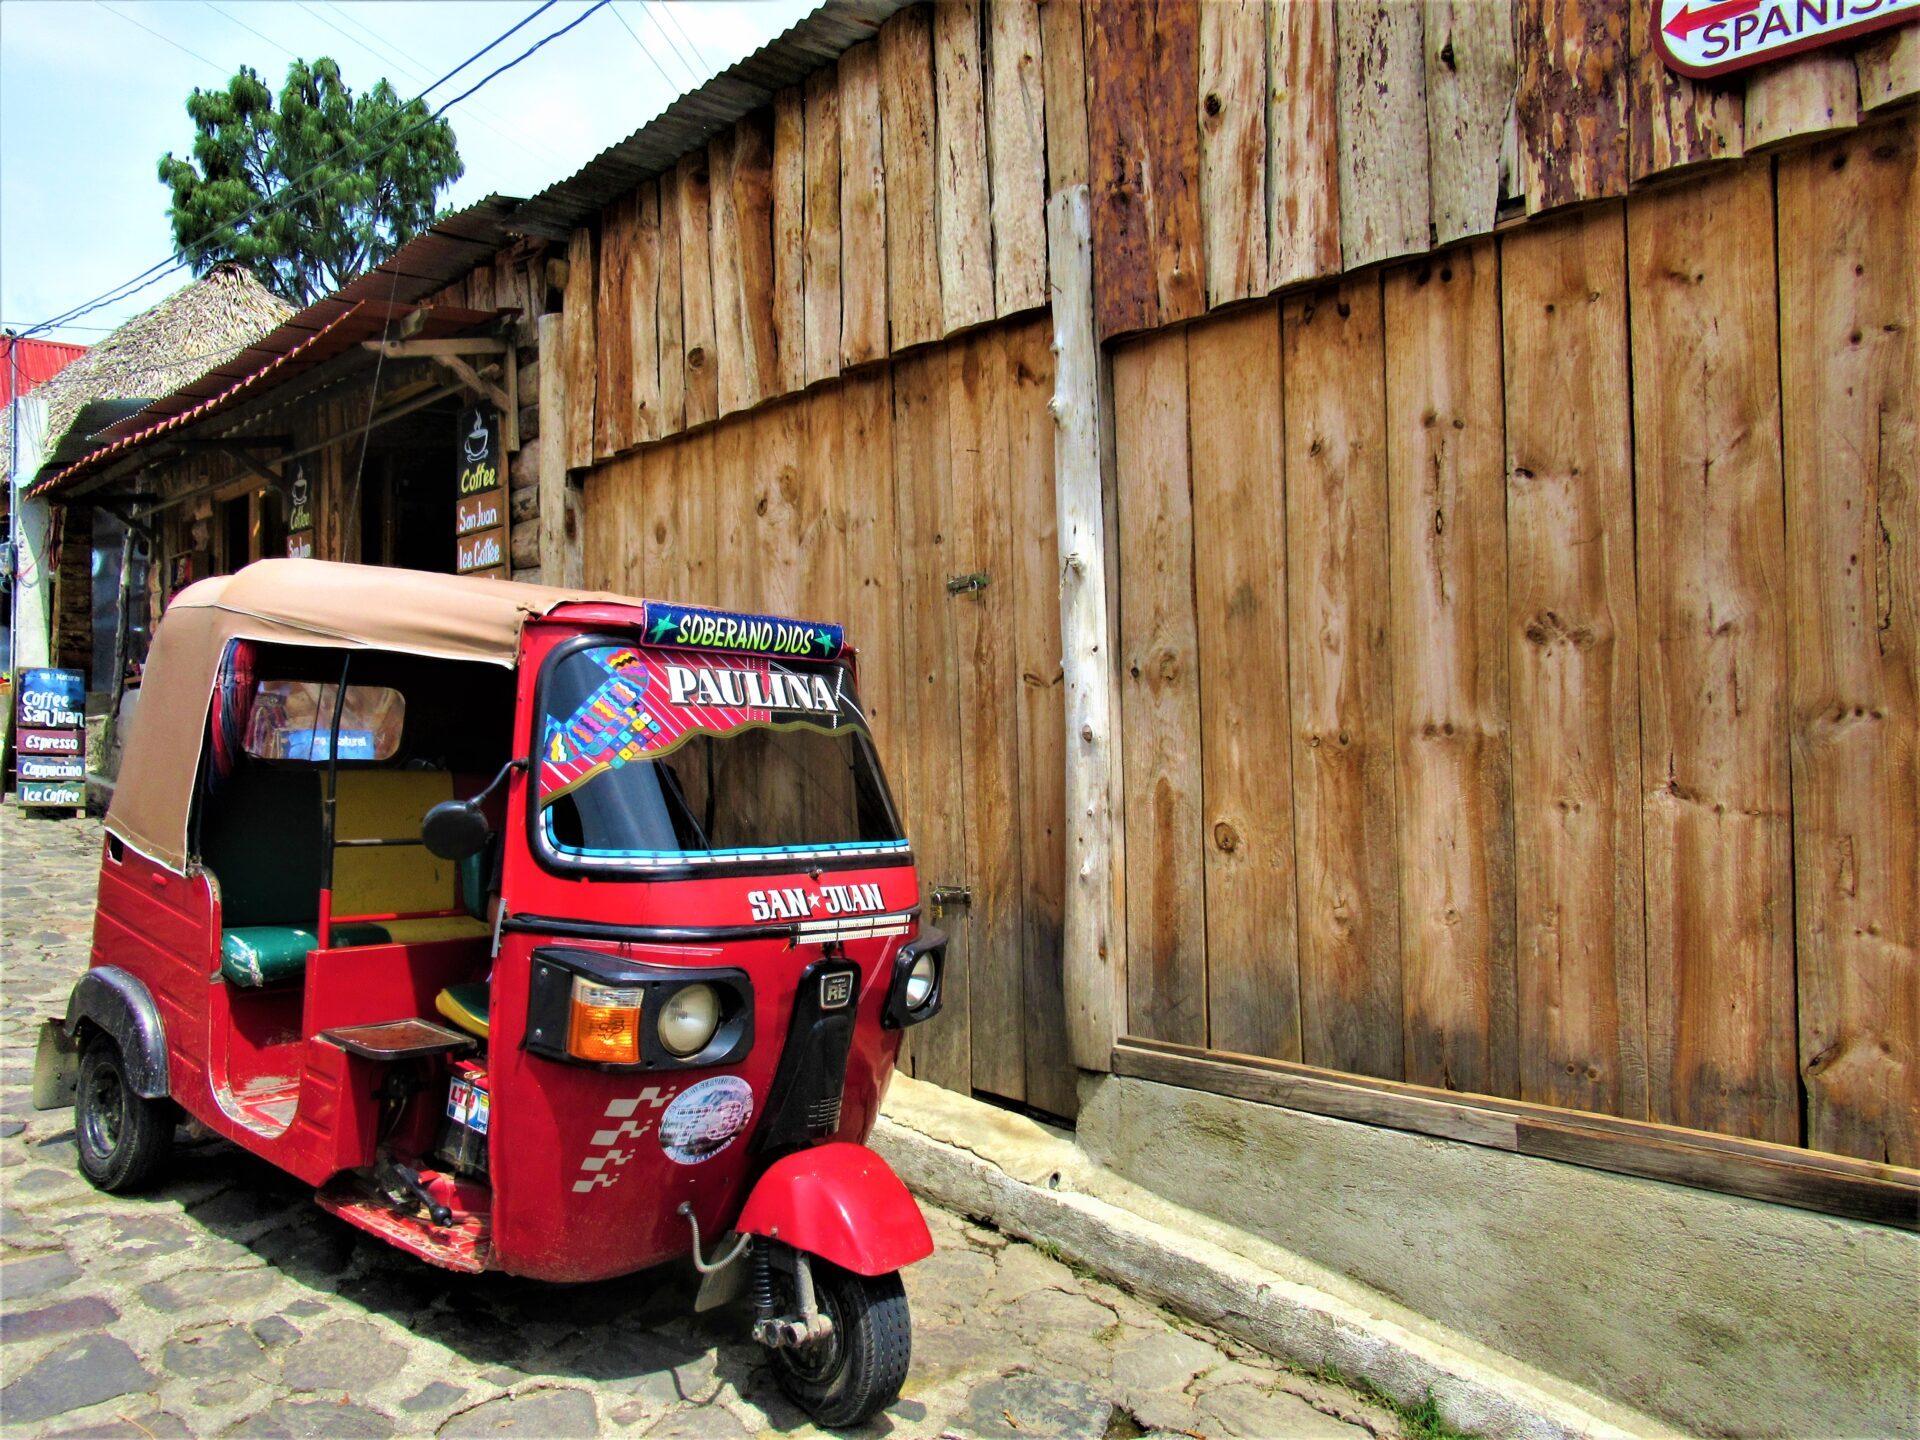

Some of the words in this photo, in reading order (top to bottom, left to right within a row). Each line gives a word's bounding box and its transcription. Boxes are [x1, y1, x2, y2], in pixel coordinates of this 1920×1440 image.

[1701, 0, 1901, 58] SPANI
[461, 463, 496, 493] Coffee
[459, 507, 476, 532] San
[477, 501, 497, 529] Juan
[459, 545, 473, 569] Ice
[474, 538, 500, 566] Coffee
[676, 614, 772, 650] SOBERANO
[774, 624, 815, 654] DIOS
[22, 691, 69, 709] Coffee
[664, 665, 841, 713] PAULINA
[25, 735, 78, 750] Espresso
[337, 736, 367, 747] atural
[22, 762, 82, 778] Cappuccino
[23, 787, 41, 802] Ice
[43, 788, 80, 805] Coffee
[747, 888, 811, 921] SAN
[820, 883, 886, 914] JUAN
[827, 983, 848, 1001] RE
